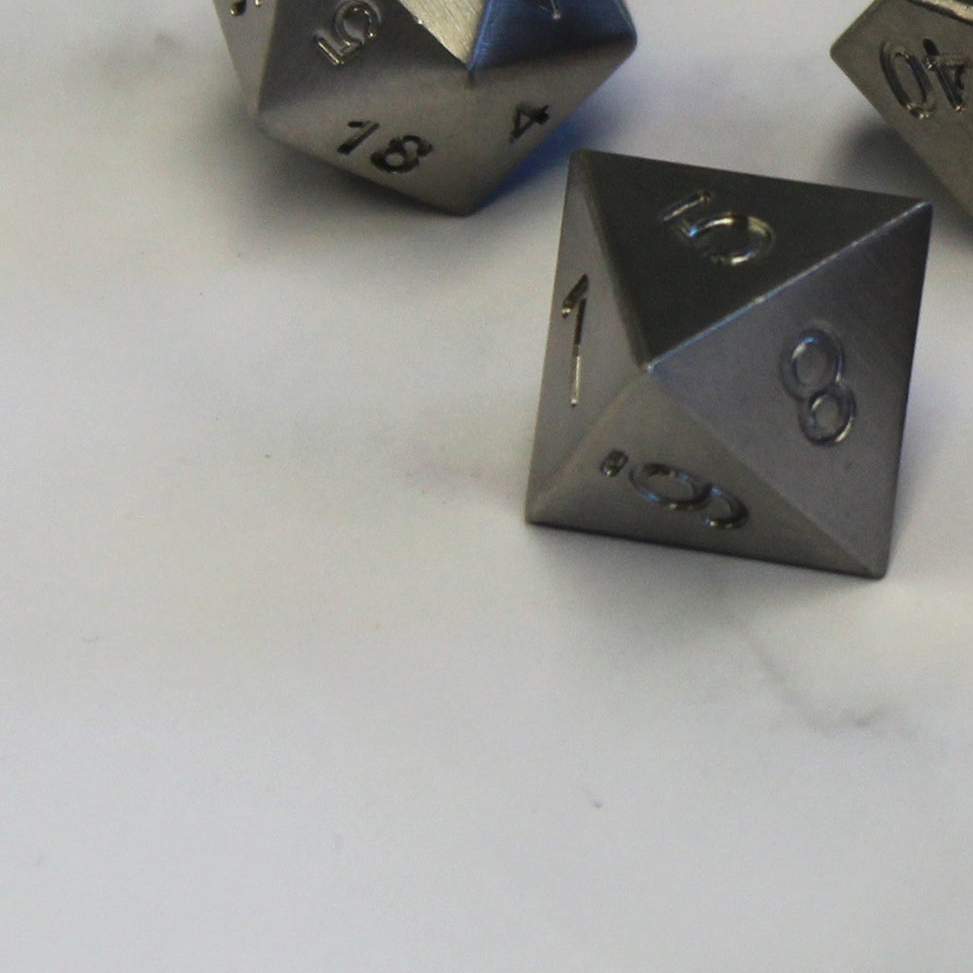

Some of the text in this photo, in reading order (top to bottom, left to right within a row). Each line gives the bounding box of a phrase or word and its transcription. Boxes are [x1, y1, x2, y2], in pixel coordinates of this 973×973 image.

[879, 38, 973, 120] 40
[337, 121, 434, 175] 18
[509, 104, 552, 143] 4
[659, 189, 775, 266] 5
[561, 273, 589, 407] 1
[781, 320, 858, 447] 8
